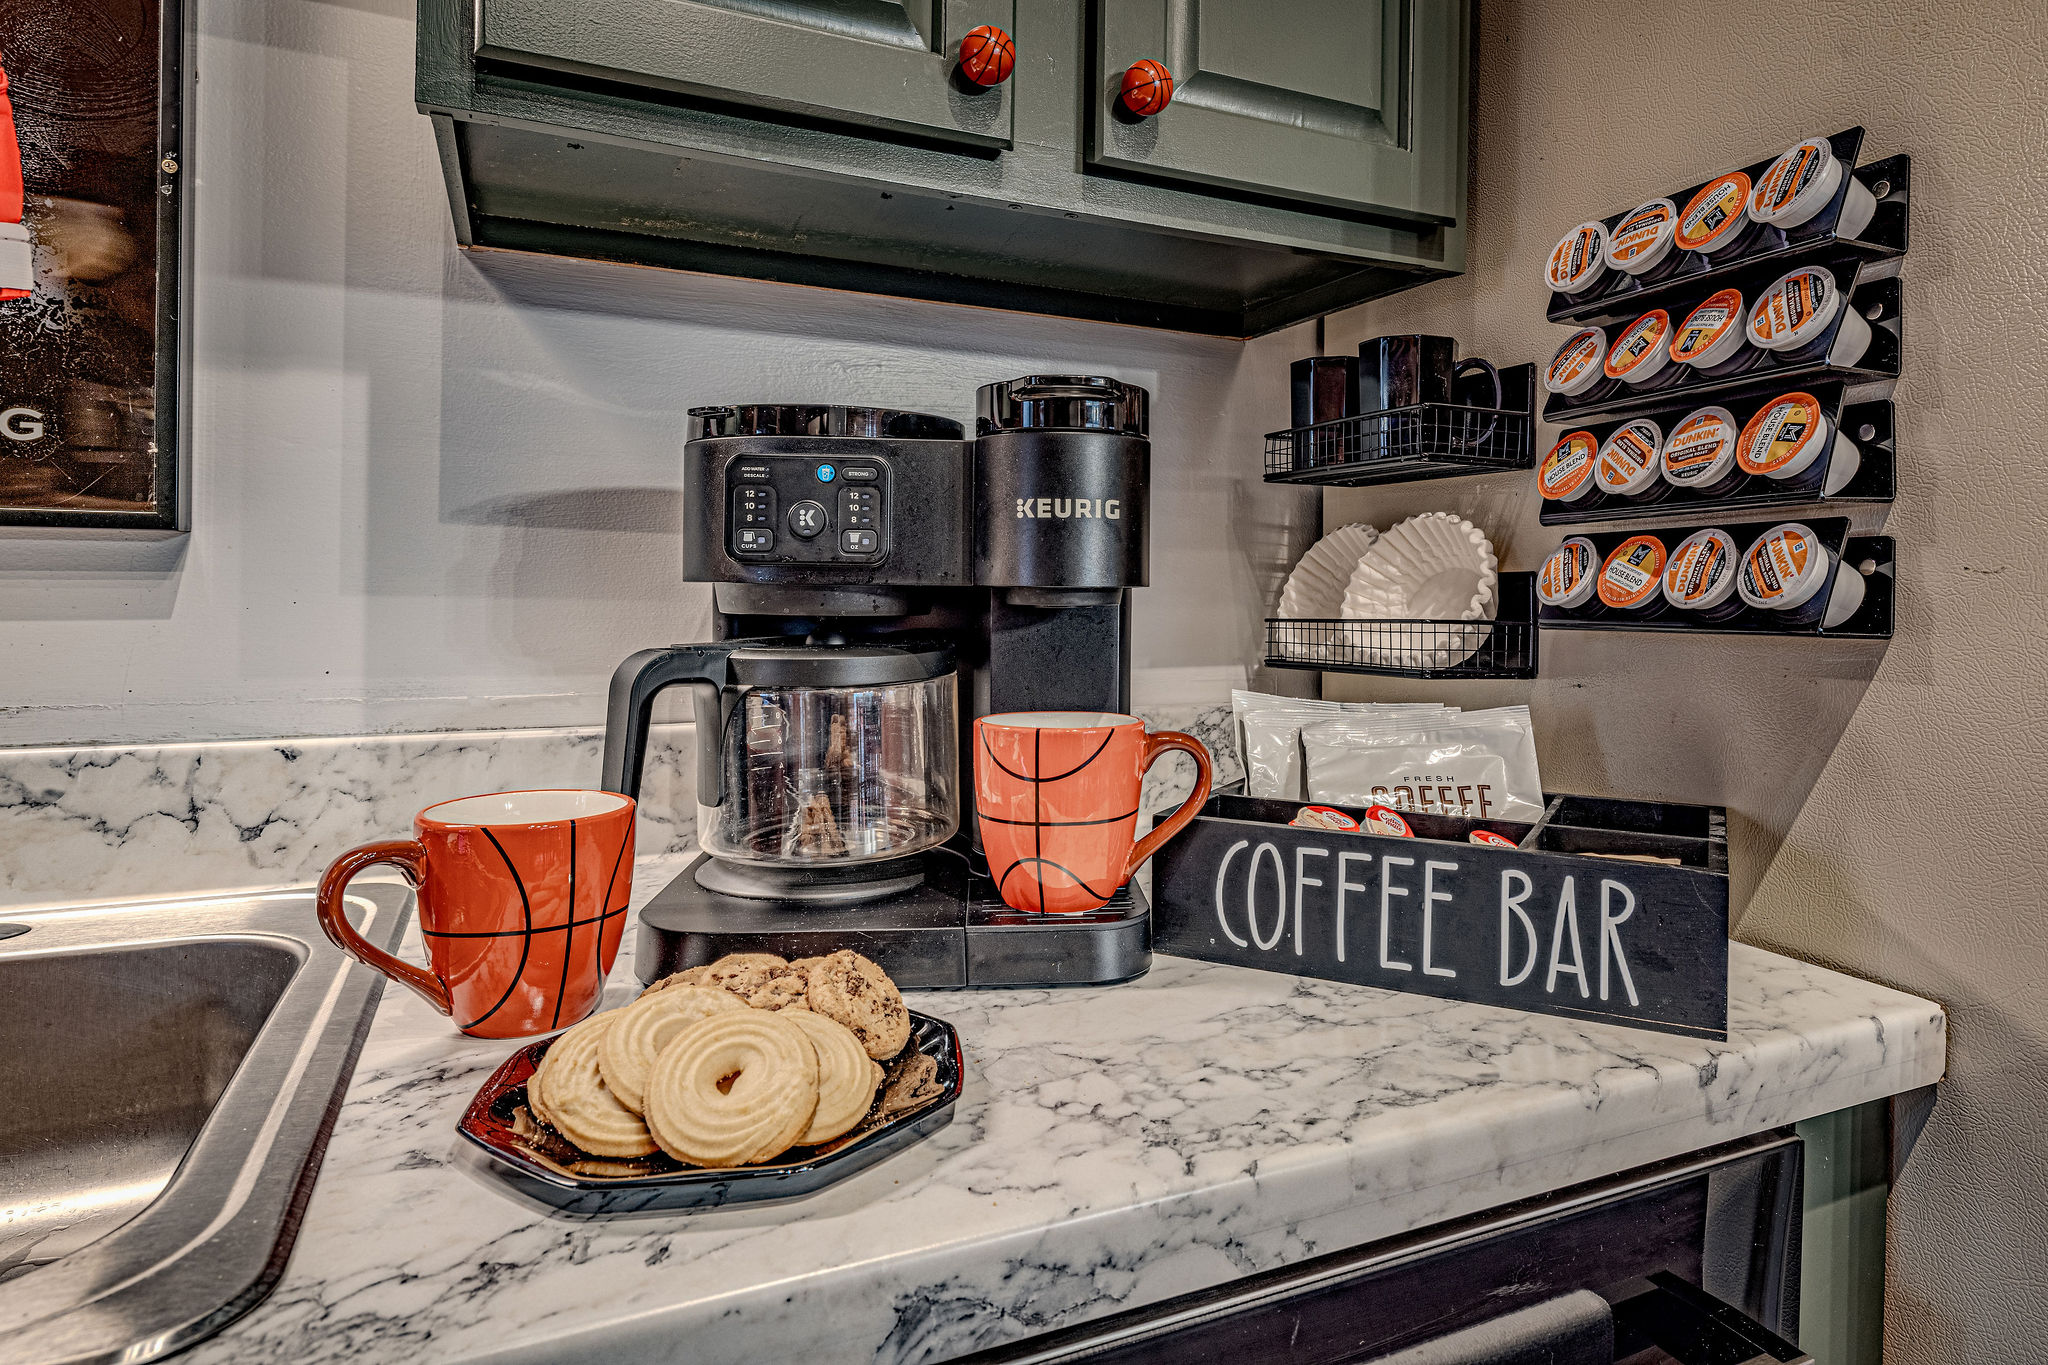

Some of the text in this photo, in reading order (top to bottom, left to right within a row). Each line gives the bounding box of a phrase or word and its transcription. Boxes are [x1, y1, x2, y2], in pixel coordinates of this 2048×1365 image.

[0, 407, 43, 440] G
[1765, 406, 1786, 433] HOUSE
[1672, 427, 1720, 448] DUNKIN'
[1754, 433, 1770, 458] BLEND
[1670, 442, 1717, 459] ORIGINAL BLEND
[1548, 466, 1566, 483] HOUSE
[1566, 453, 1586, 469] BLEND
[1607, 449, 1637, 477] DUNKIN'
[745, 490, 755, 498] 12
[849, 492, 859, 500] 12
[744, 502, 755, 510] 10
[849, 504, 859, 512] 10
[1017, 498, 1120, 519] KEURIG
[746, 514, 753, 522] 8
[851, 516, 857, 524] 8
[1677, 542, 1700, 592] DUNKIN'
[1687, 543, 1712, 593] ORIGINAL BLEND
[1770, 536, 1794, 579] DUNKIN'
[1609, 565, 1625, 578] HOUSE
[1624, 572, 1642, 587] BLEND
[1768, 569, 1779, 589] BLEND
[1403, 775, 1455, 783] FRESH
[1380, 812, 1402, 828] Coffee
[1215, 840, 1640, 1006] COFFEE BAR
